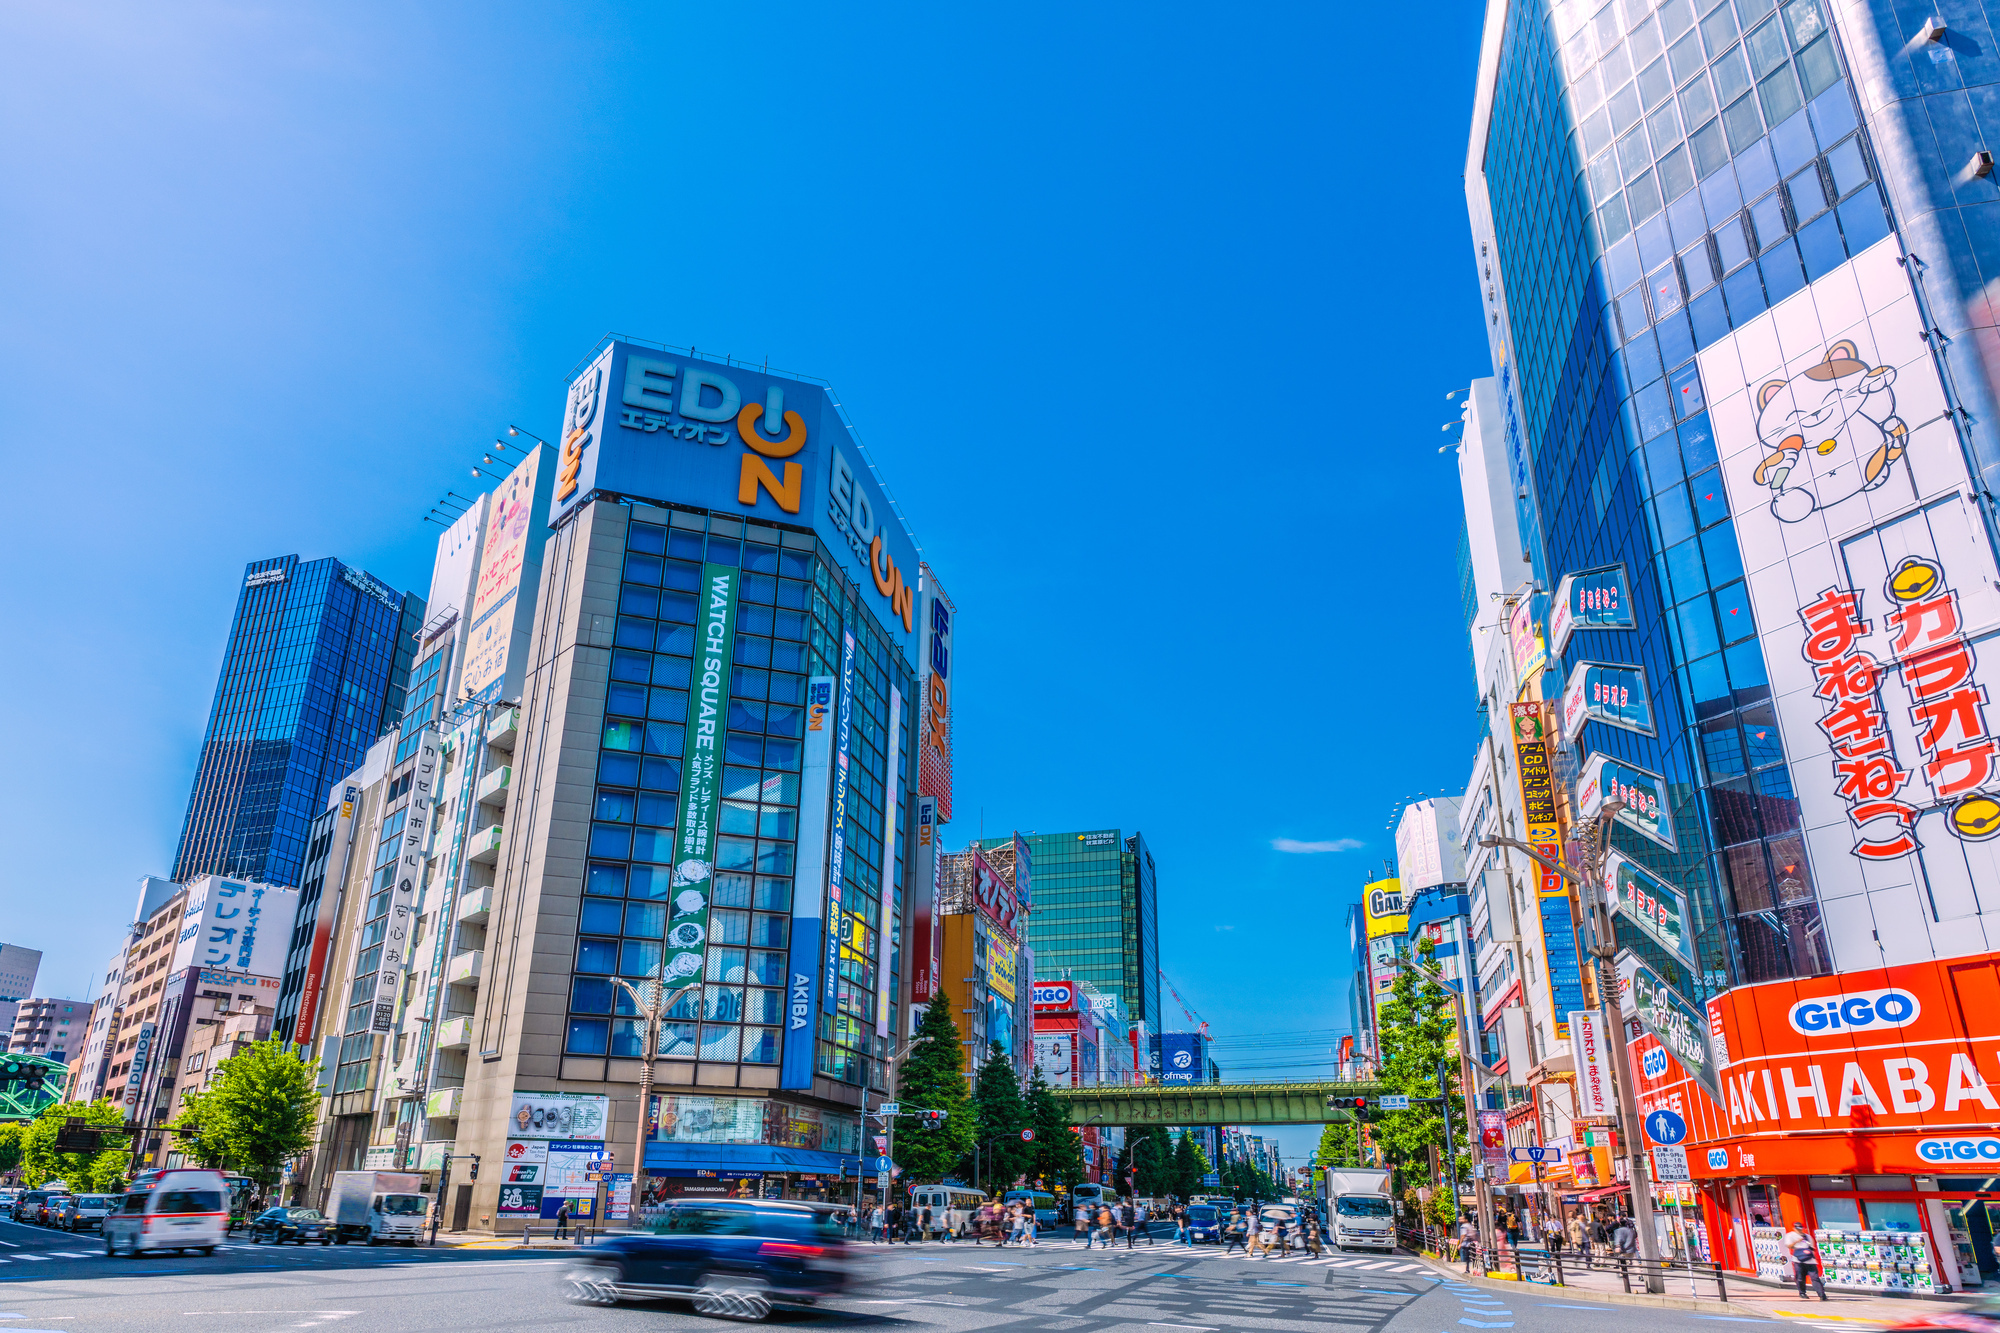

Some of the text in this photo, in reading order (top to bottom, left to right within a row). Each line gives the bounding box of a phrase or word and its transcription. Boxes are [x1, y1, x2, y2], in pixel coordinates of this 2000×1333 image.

[557, 366, 600, 502] EDION
[619, 408, 731, 445] エディオン
[622, 354, 807, 514] EDION
[830, 444, 913, 633] EDION
[1580, 587, 1617, 613] まねきねこ
[696, 575, 730, 750] WATCH SQUARE
[809, 682, 831, 731] EDION
[1513, 704, 1538, 717] 激安
[1594, 681, 1628, 707] カラオケ
[1887, 592, 2000, 808] カラオケ
[1798, 586, 1924, 861] まねきねこ
[1519, 744, 1544, 753] ゲーム
[1523, 755, 1543, 765] CD
[1522, 766, 1548, 776] アイドル
[1523, 777, 1550, 788] アニメ
[404, 744, 435, 867] カプセルホテル
[683, 752, 702, 853] 人気ブランド多数取り揃え
[1525, 788, 1550, 799] コミック
[1528, 801, 1551, 810] ホビー
[1528, 812, 1553, 822] フィギュア
[830, 902, 840, 938] 免税
[1627, 881, 1667, 926] カラオケ
[205, 881, 247, 966] テレオン
[237, 888, 265, 968] オーディオ専門店
[382, 904, 409, 986] 安心お宿
[260, 979, 280, 989] 110
[827, 939, 837, 998] TAX FREE
[297, 973, 316, 1039] Home Electronics Store
[791, 972, 810, 1030] AKIBA
[1795, 993, 1914, 1031] GiGO
[1582, 1022, 1596, 1056] カラオケ
[125, 1028, 150, 1105] sound 110
[1644, 1049, 1667, 1077] GiGO
[1588, 1065, 1604, 1112] まねきねこ
[1730, 1052, 2000, 1125] AKIHABA
[1023, 1131, 1032, 1139] 50
[1531, 1149, 1542, 1158] 17
[1920, 1140, 2000, 1160] GiGO
[1708, 1149, 1727, 1168] GiGO
[1738, 1146, 1755, 1168] 2号館
